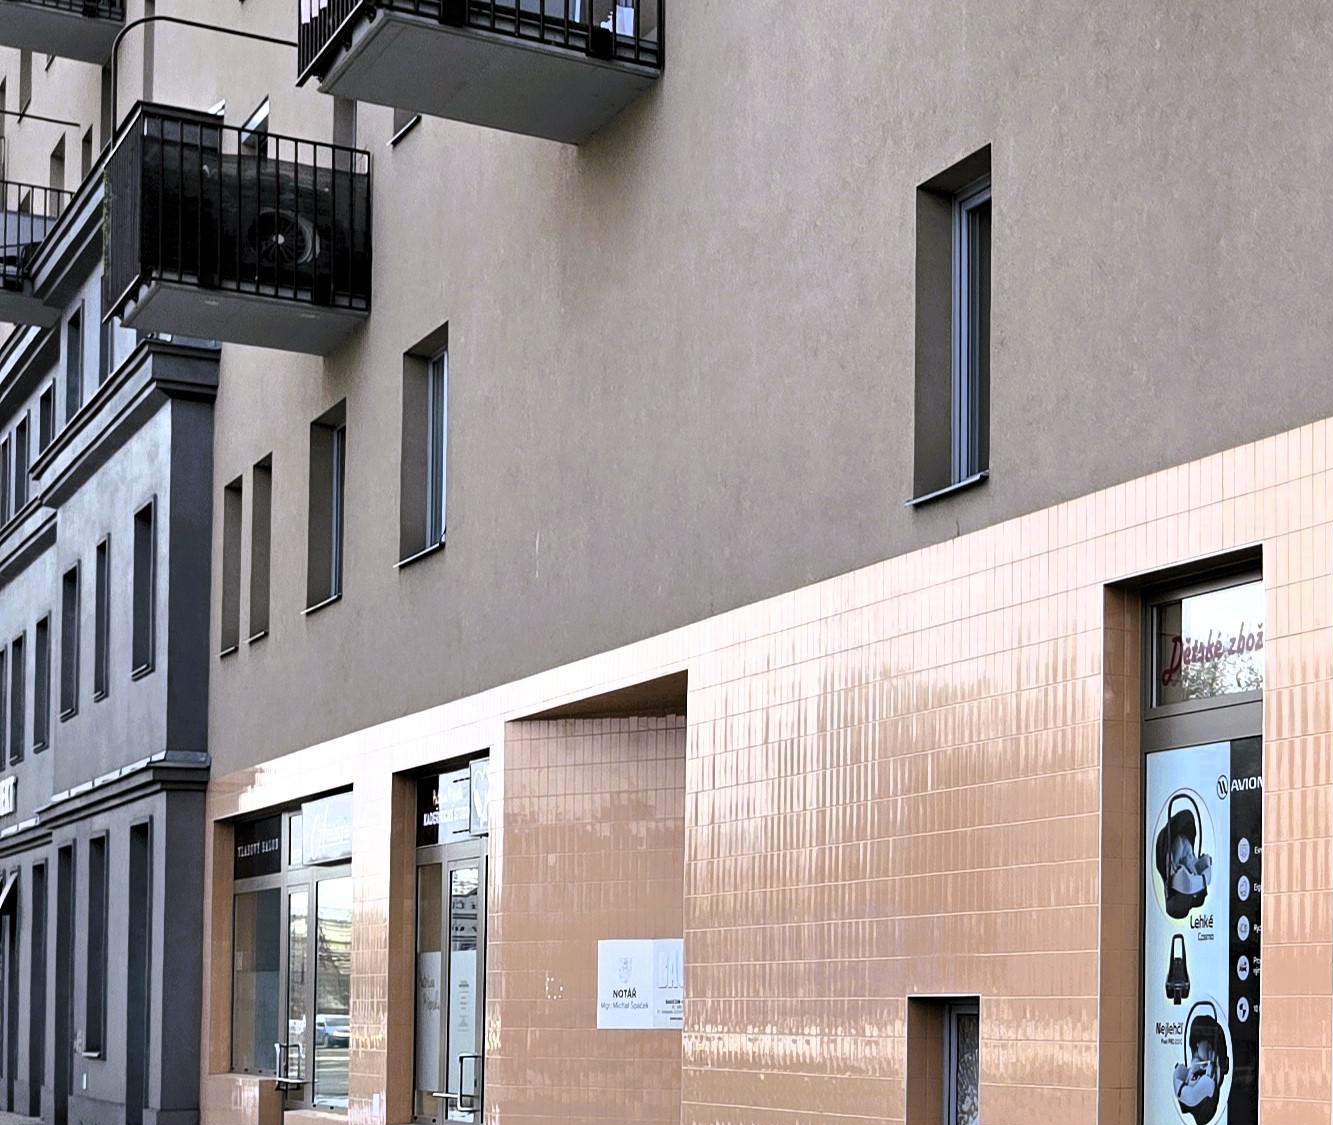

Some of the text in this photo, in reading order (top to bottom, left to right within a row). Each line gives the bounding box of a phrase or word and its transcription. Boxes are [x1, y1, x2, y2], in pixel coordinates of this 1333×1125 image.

[1162, 629, 1223, 687] Dětské
[1190, 915, 1214, 929] Lehké
[613, 987, 637, 999] NOTÁŘ
